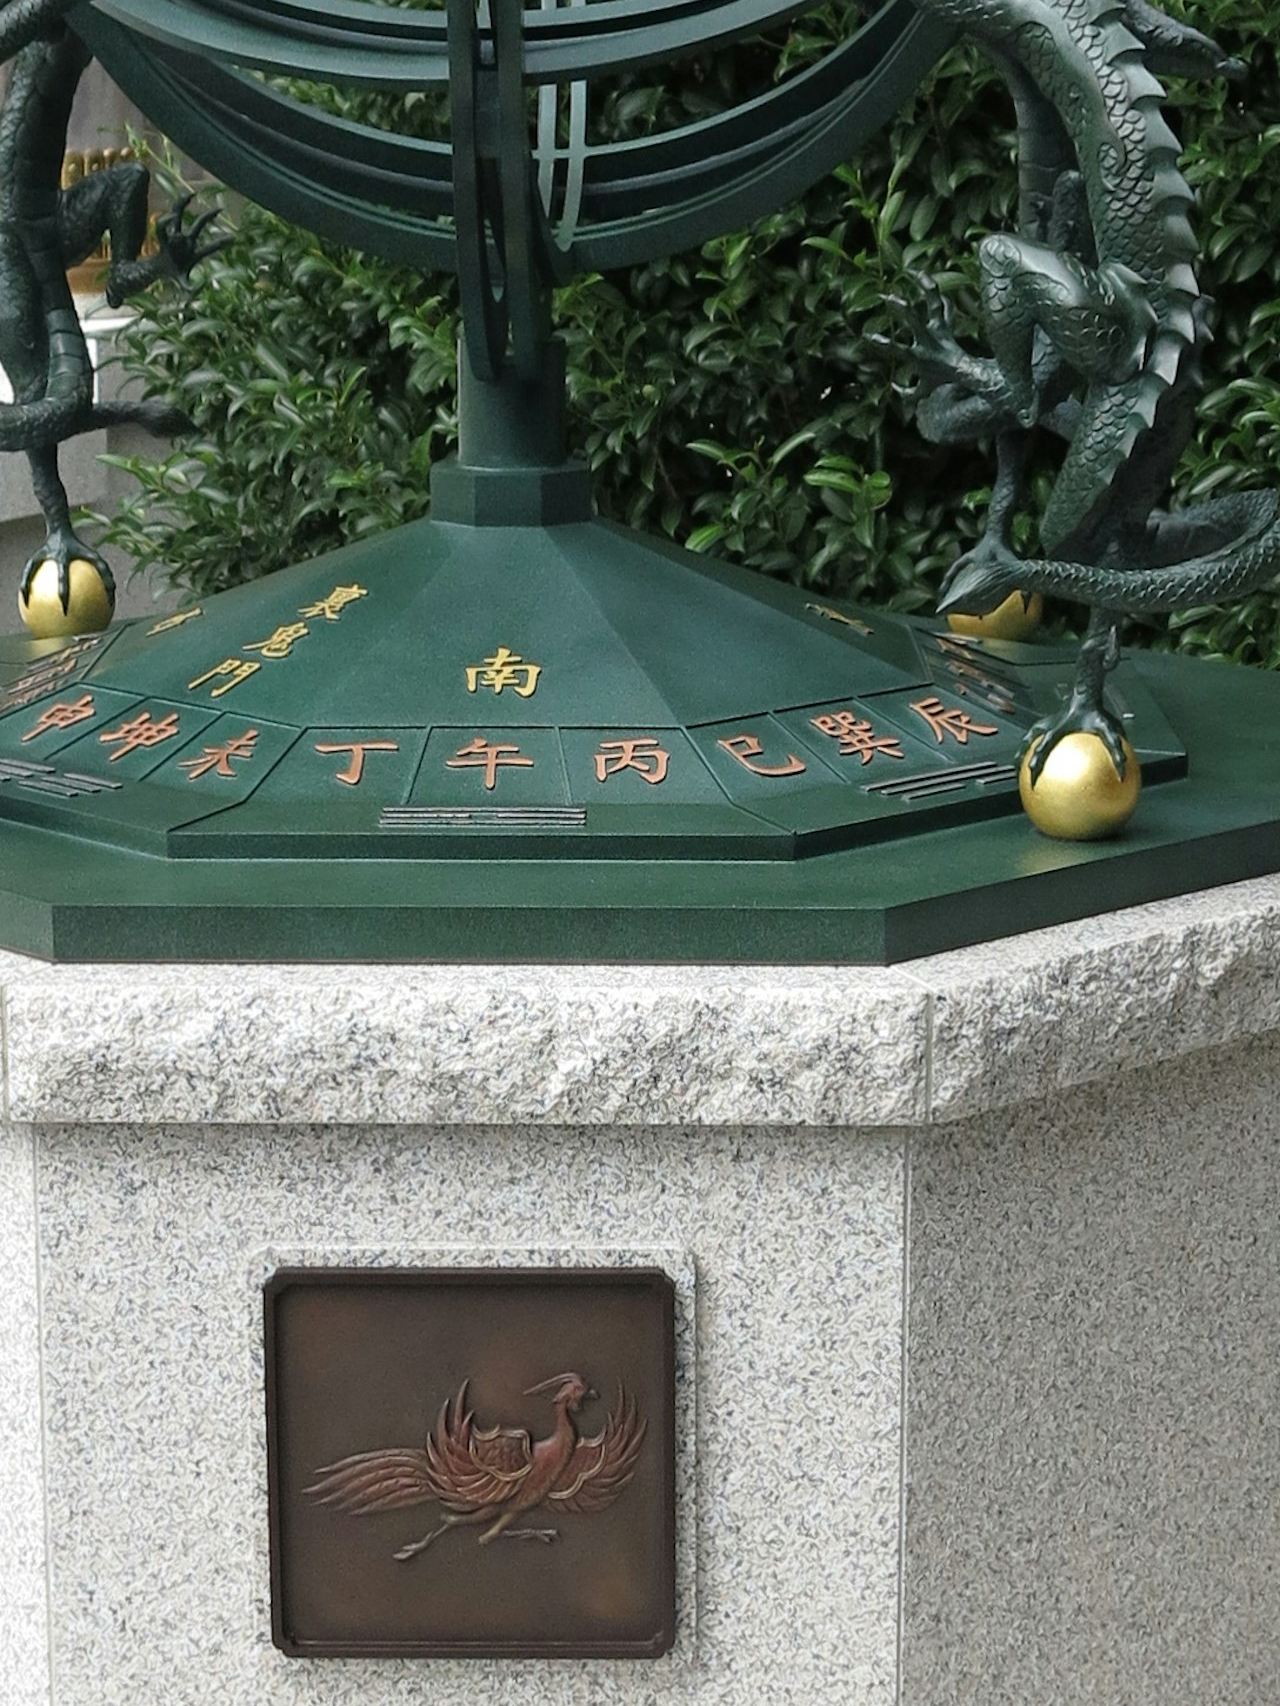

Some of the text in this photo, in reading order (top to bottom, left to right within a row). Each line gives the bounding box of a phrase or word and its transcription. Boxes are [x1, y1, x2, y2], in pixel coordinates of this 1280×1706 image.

[464, 646, 542, 698] 南
[21, 693, 259, 780] 申 坤 未
[809, 710, 904, 765] 巽
[909, 697, 998, 744] 辰
[314, 736, 670, 790] 丁 午 丙
